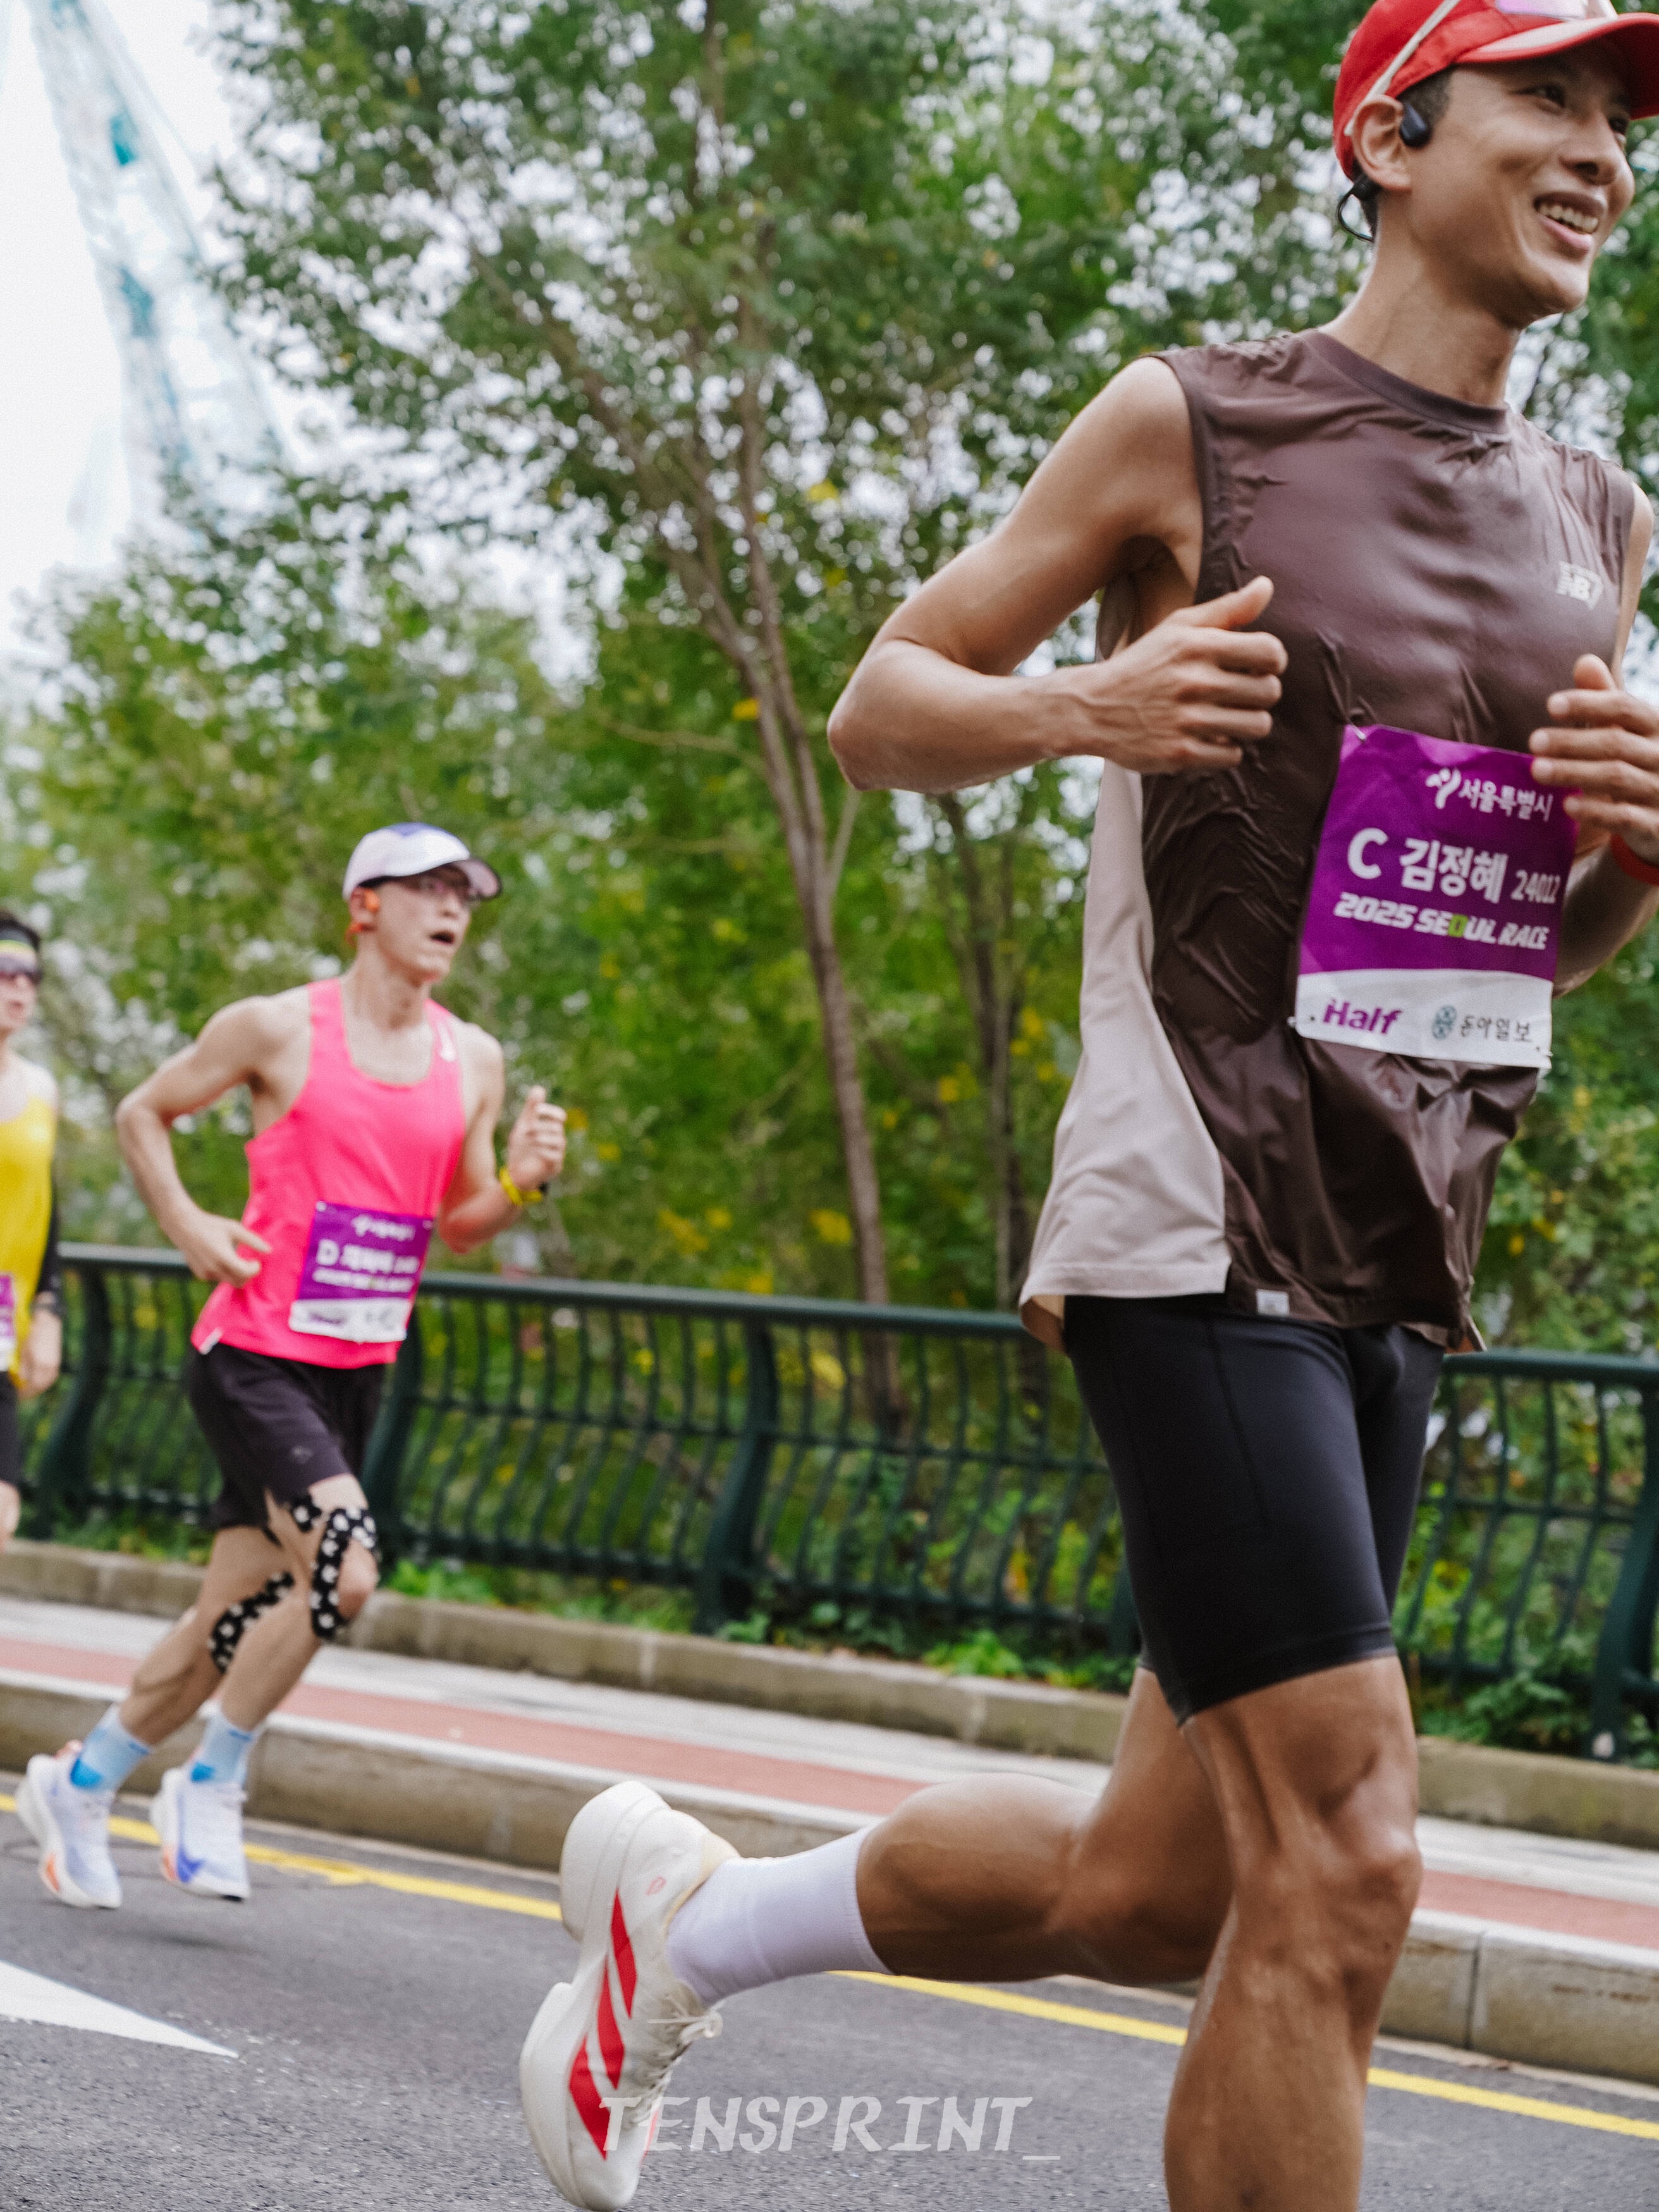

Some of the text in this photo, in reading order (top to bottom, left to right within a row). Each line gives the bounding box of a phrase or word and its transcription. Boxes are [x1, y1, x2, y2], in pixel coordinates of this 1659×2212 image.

[1459, 778, 1553, 821] 서울특별시
[1348, 828, 1388, 879] C
[1400, 838, 1509, 904] 김정혜
[1334, 892, 1549, 950] 2025 SEOUL RACE
[1323, 1000, 1402, 1035] Half
[1461, 1015, 1531, 1043] 동아일보
